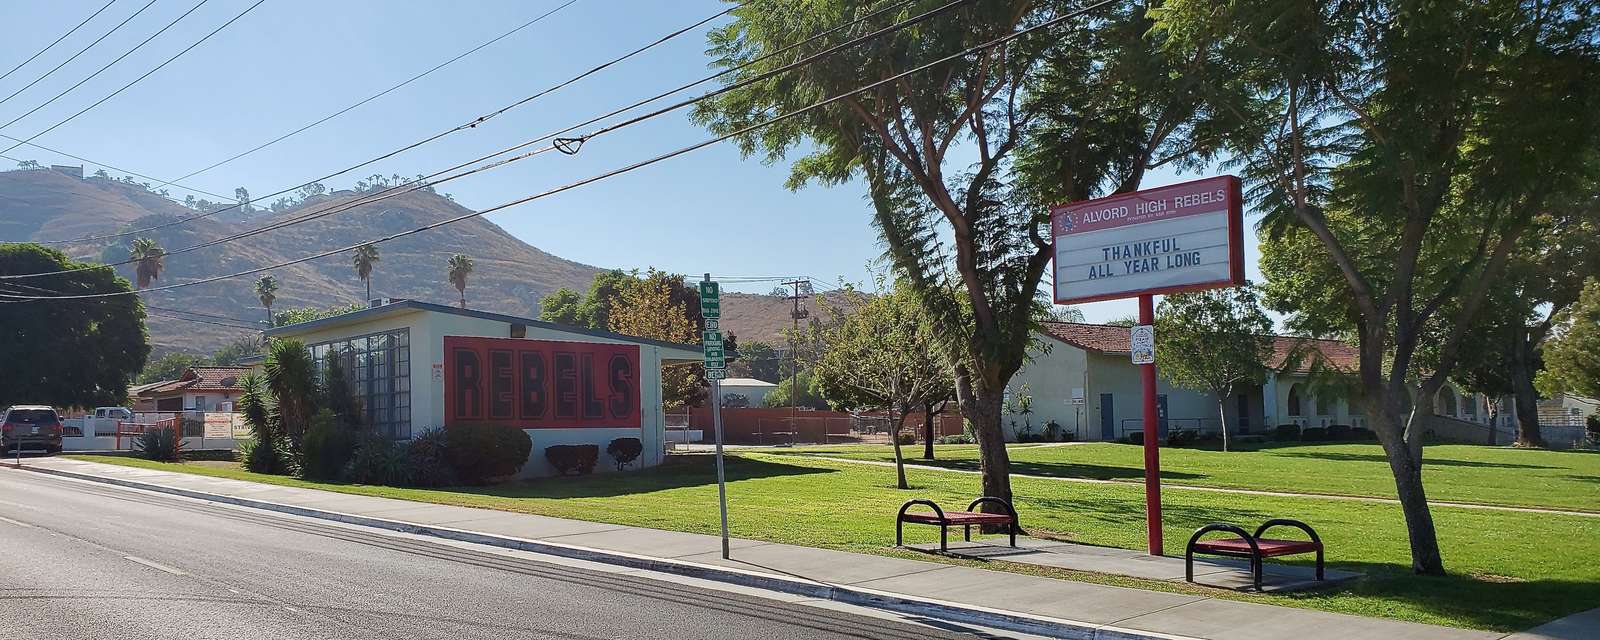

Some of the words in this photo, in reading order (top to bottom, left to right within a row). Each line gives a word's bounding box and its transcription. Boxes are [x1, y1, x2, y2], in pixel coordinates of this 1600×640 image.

[1082, 206, 1129, 224] ALVORD
[1135, 200, 1167, 216] HIGH
[1174, 189, 1225, 209] REBELS
[1088, 264, 1113, 280] ALL
[1124, 257, 1159, 275] YEAR
[1167, 251, 1201, 269] LONG
[1102, 238, 1180, 261] THANKFUL
[453, 347, 634, 420] REBELS
